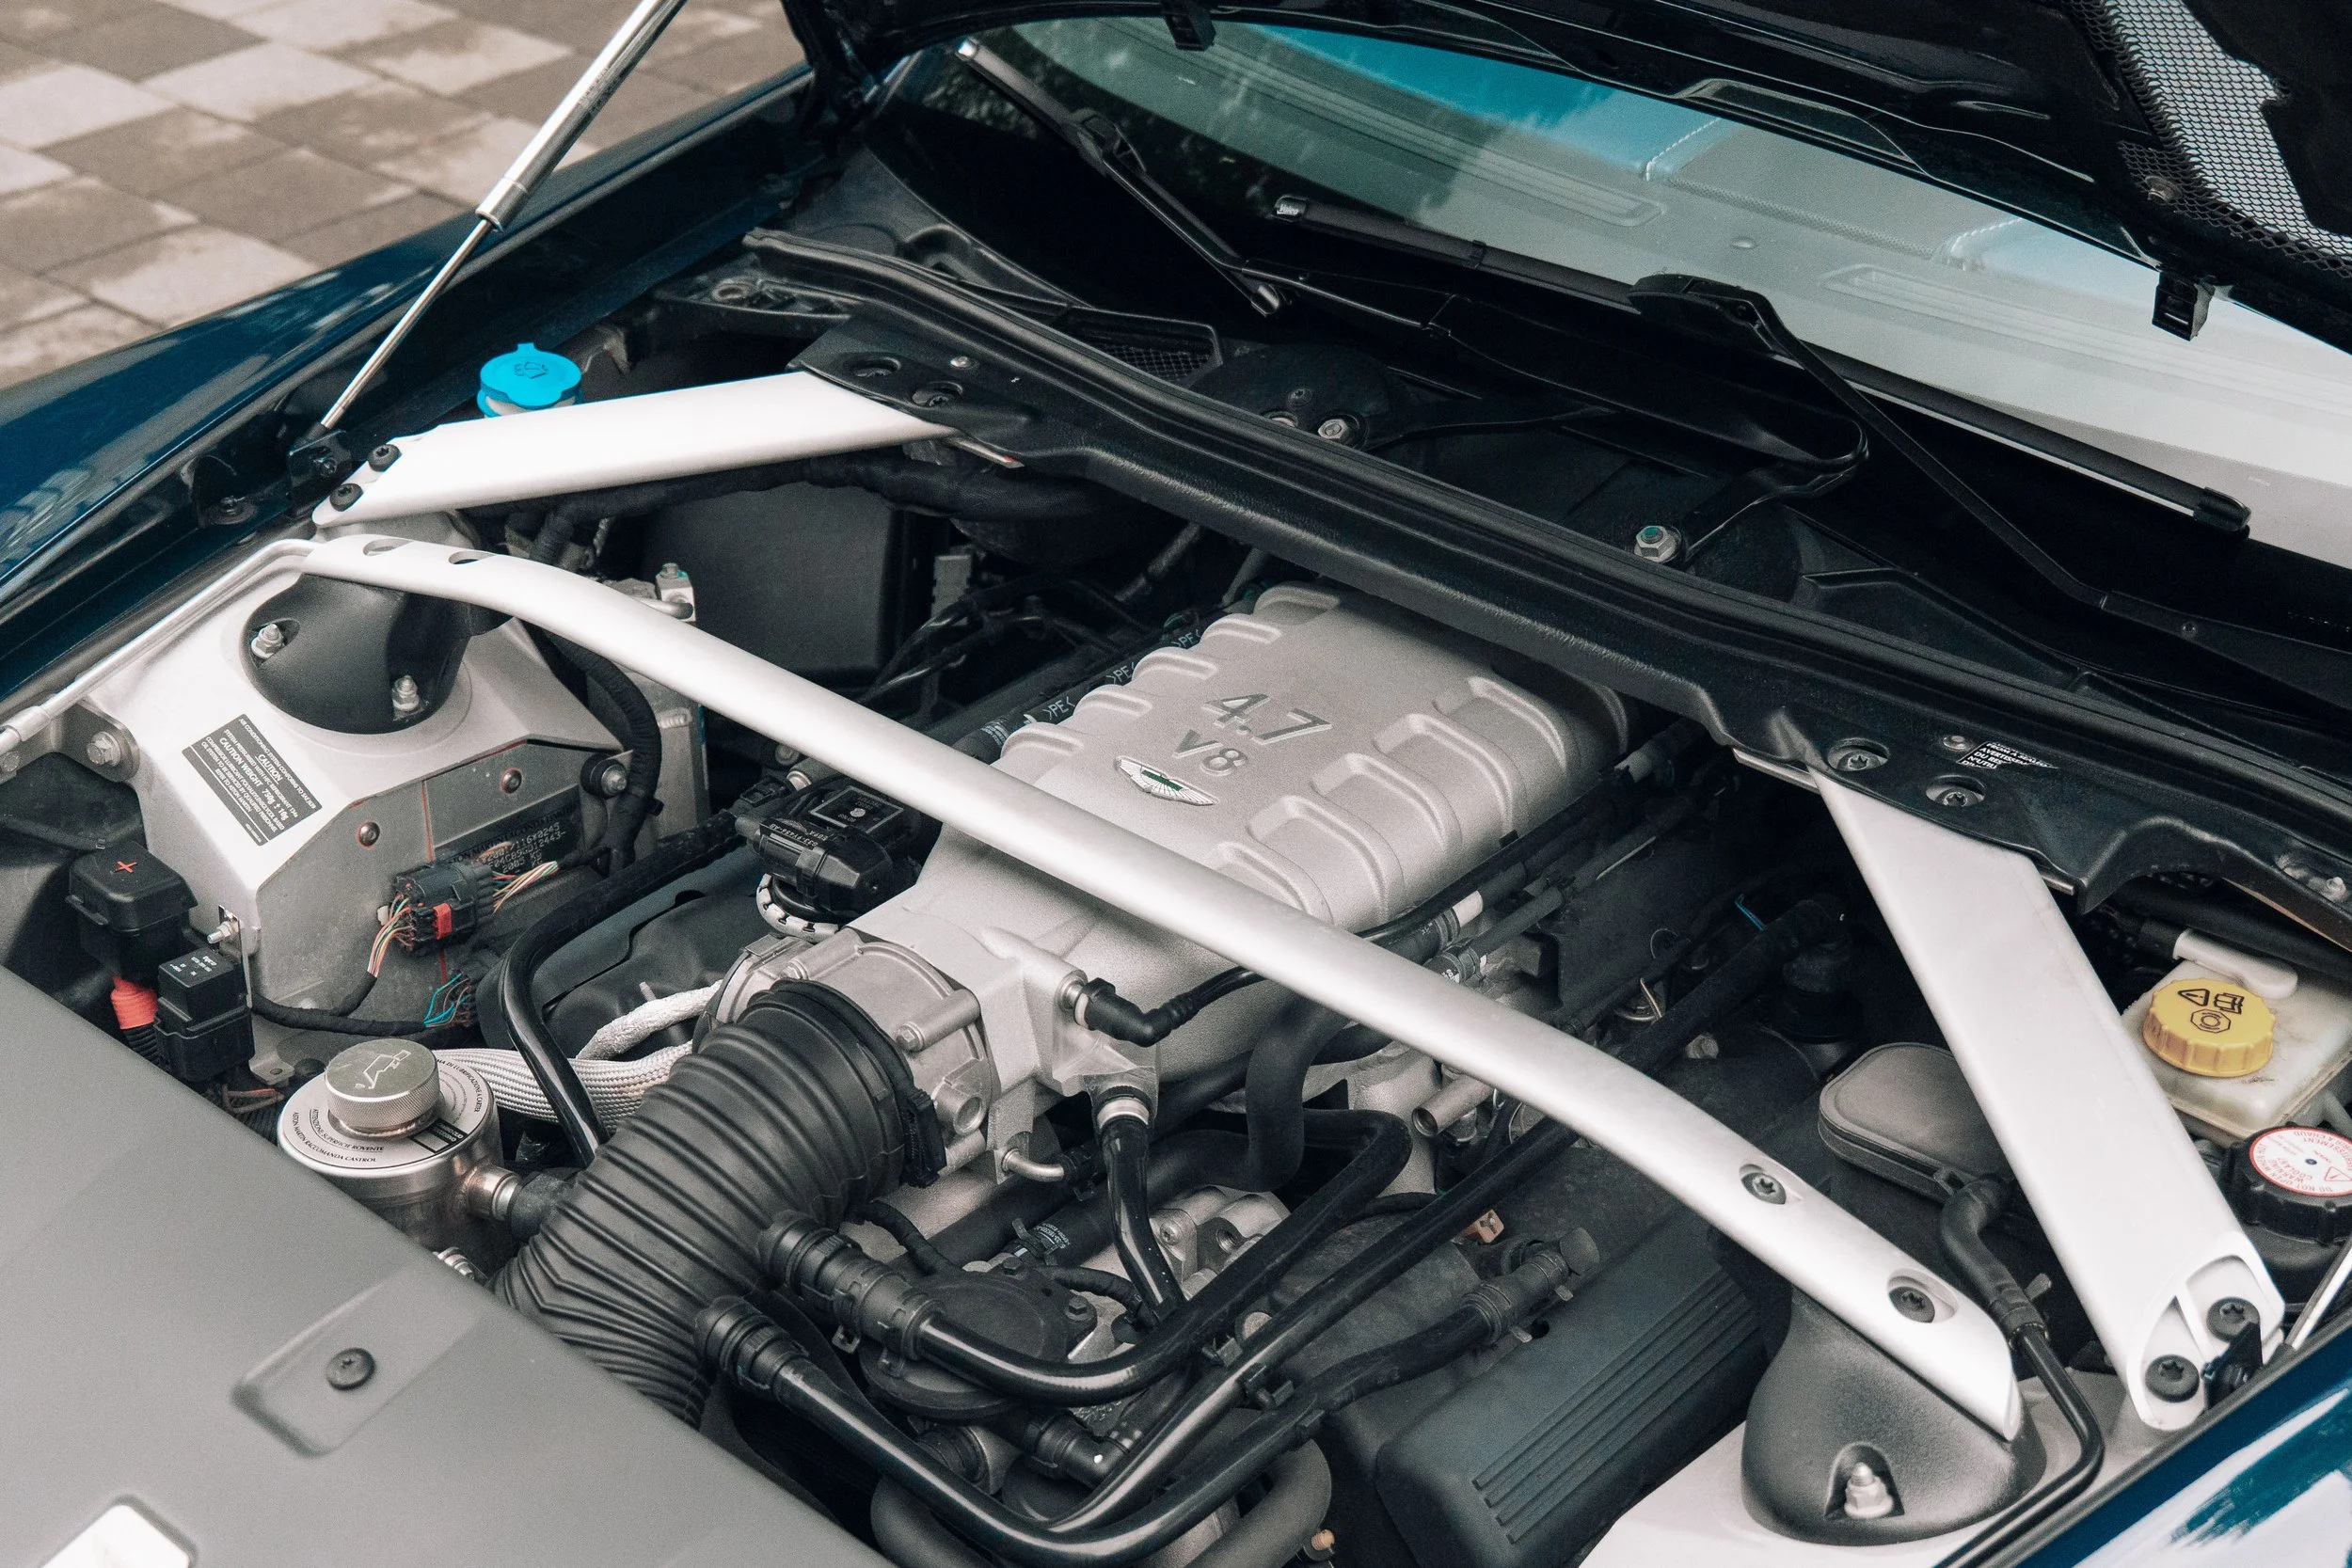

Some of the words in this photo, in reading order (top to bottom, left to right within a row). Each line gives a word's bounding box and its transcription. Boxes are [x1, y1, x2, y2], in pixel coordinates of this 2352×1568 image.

[1202, 693, 1333, 745] 4.7
[217, 736, 245, 765] CAUTION
[239, 762, 263, 787] WEIGHT
[259, 788, 277, 804] 750g
[275, 807, 290, 820] 10g
[223, 728, 238, 744] SYSTEM
[253, 765, 265, 776] WITH
[262, 775, 272, 784] HFC
[268, 783, 292, 808] REFRIGERANT
[244, 724, 270, 753] CONDITIONING
[266, 752, 281, 767] SYSTEM
[278, 766, 299, 788] CONFORMS
[257, 753, 283, 782] CAUTION
[1172, 729, 1248, 776] V8
[204, 736, 227, 761] COMPRESSOR
[224, 759, 243, 780] LUBRICANT
[273, 817, 285, 830] BASED
[205, 747, 219, 762] SYSTEM
[225, 770, 242, 788] SERVICED
[242, 792, 262, 812] QUALIFIED
[258, 810, 278, 832] PERSONNEL
[214, 768, 226, 780] REFER
[227, 784, 241, 798] ASTON
[237, 796, 252, 812] MARTIN
[305, 1138, 343, 1160] RACCOMANDA
[322, 1132, 351, 1148] SUPERFICIE
